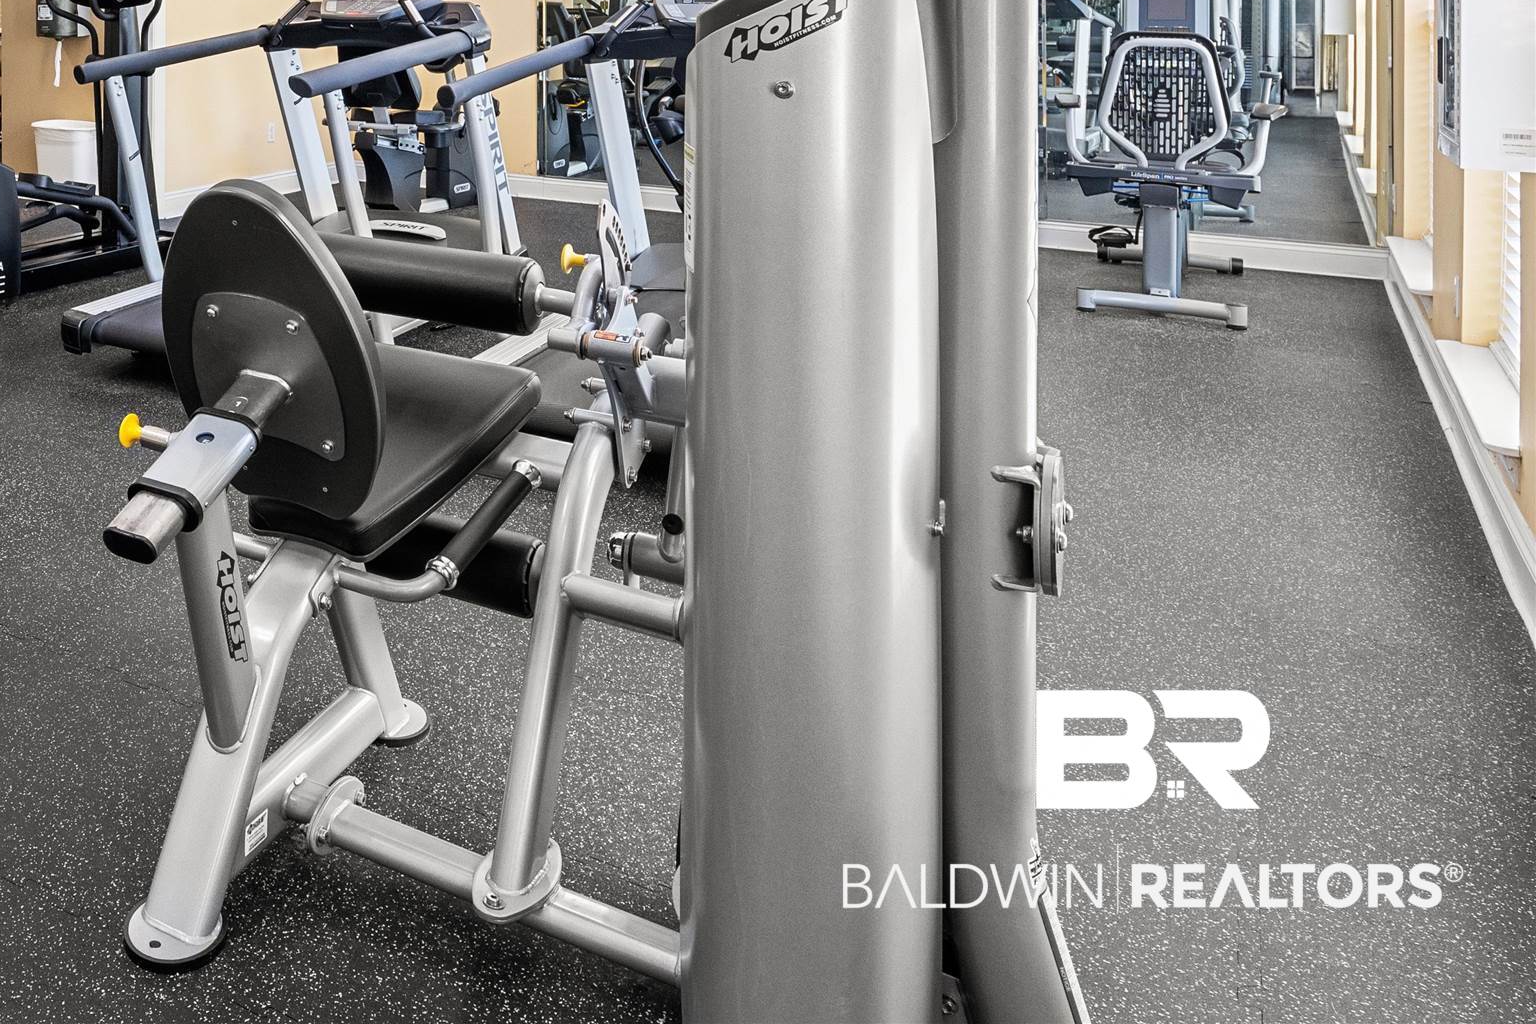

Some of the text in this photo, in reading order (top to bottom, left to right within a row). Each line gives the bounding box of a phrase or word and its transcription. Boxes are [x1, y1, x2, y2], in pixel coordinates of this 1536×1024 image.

[773, 14, 838, 48] HOISTFITNESS.COM
[480, 92, 510, 195] SPIRIT
[216, 556, 249, 663] HOIST
